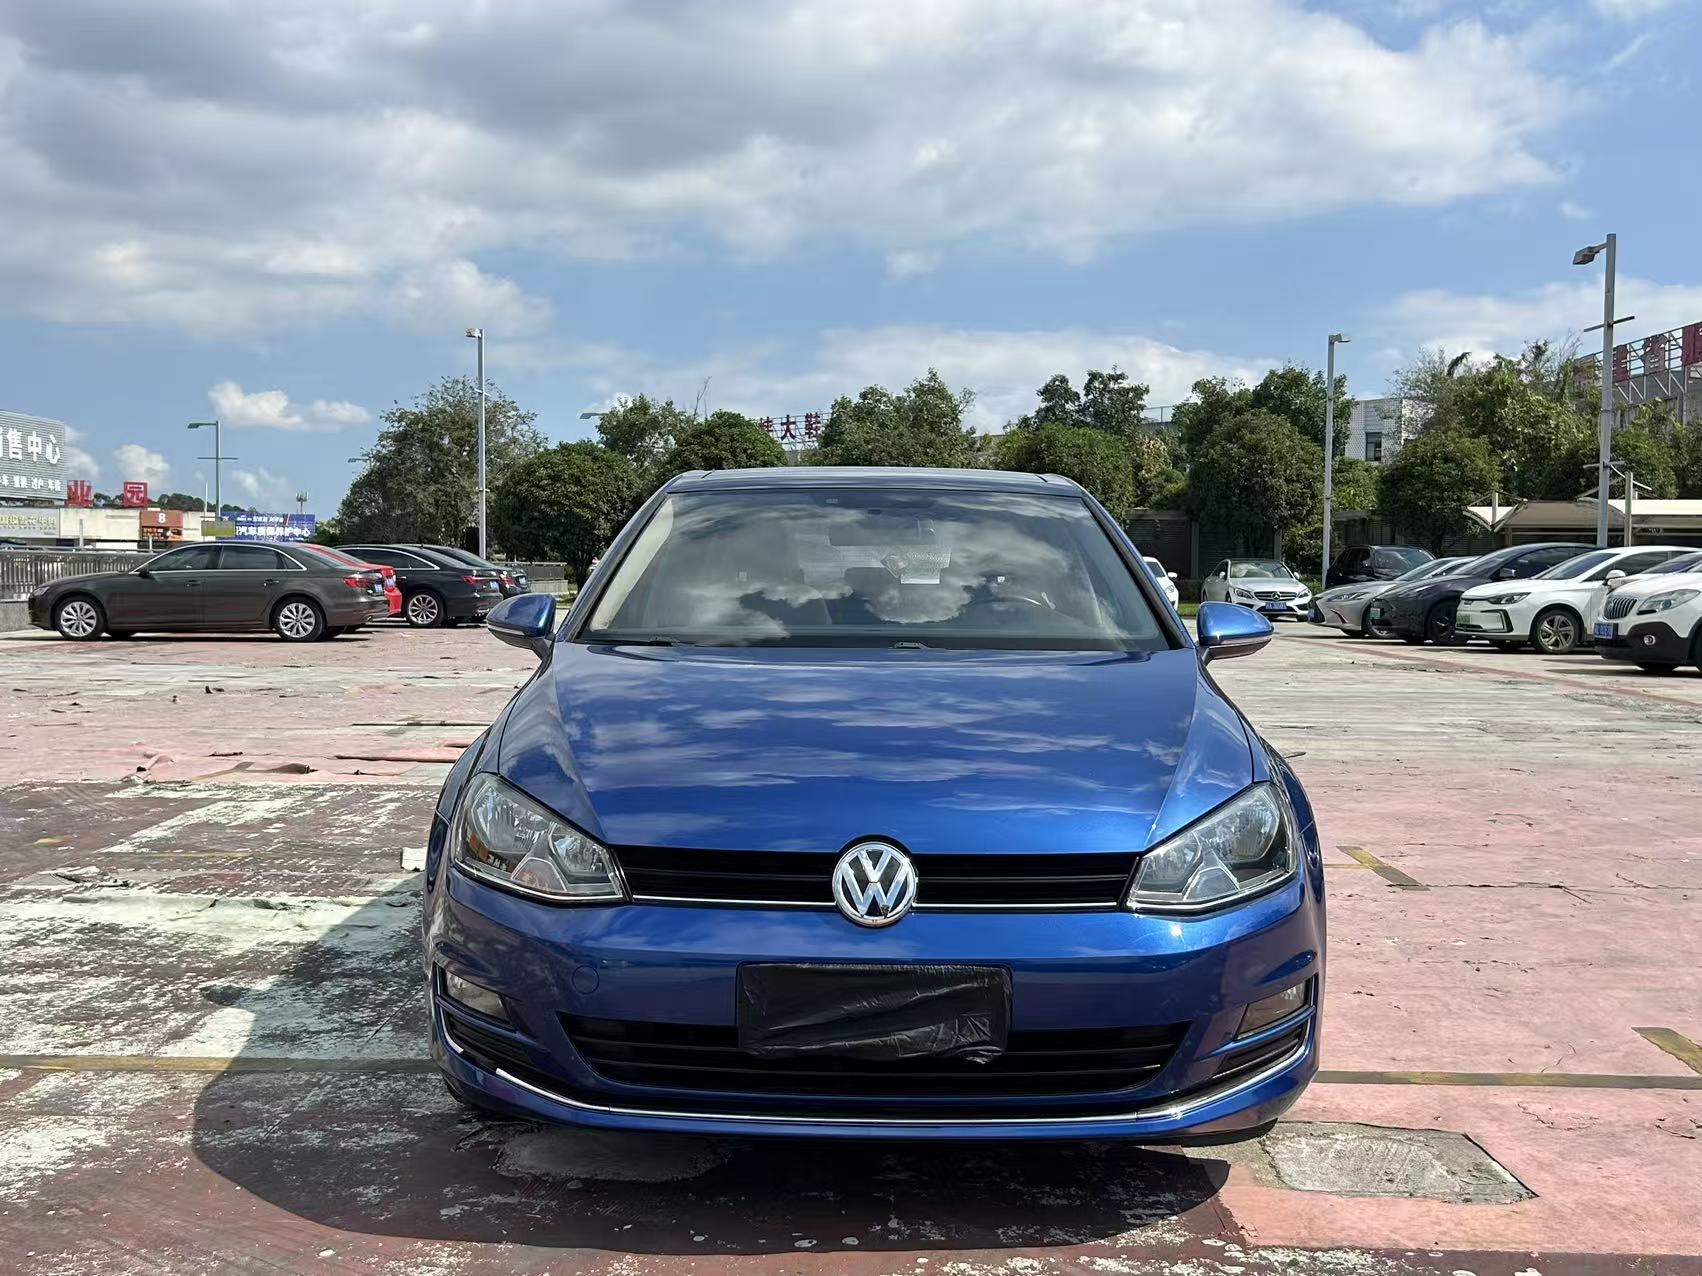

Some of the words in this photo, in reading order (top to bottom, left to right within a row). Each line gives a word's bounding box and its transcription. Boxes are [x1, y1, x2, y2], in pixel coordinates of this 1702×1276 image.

[0, 427, 61, 464] 售中心
[158, 513, 166, 523] 8
